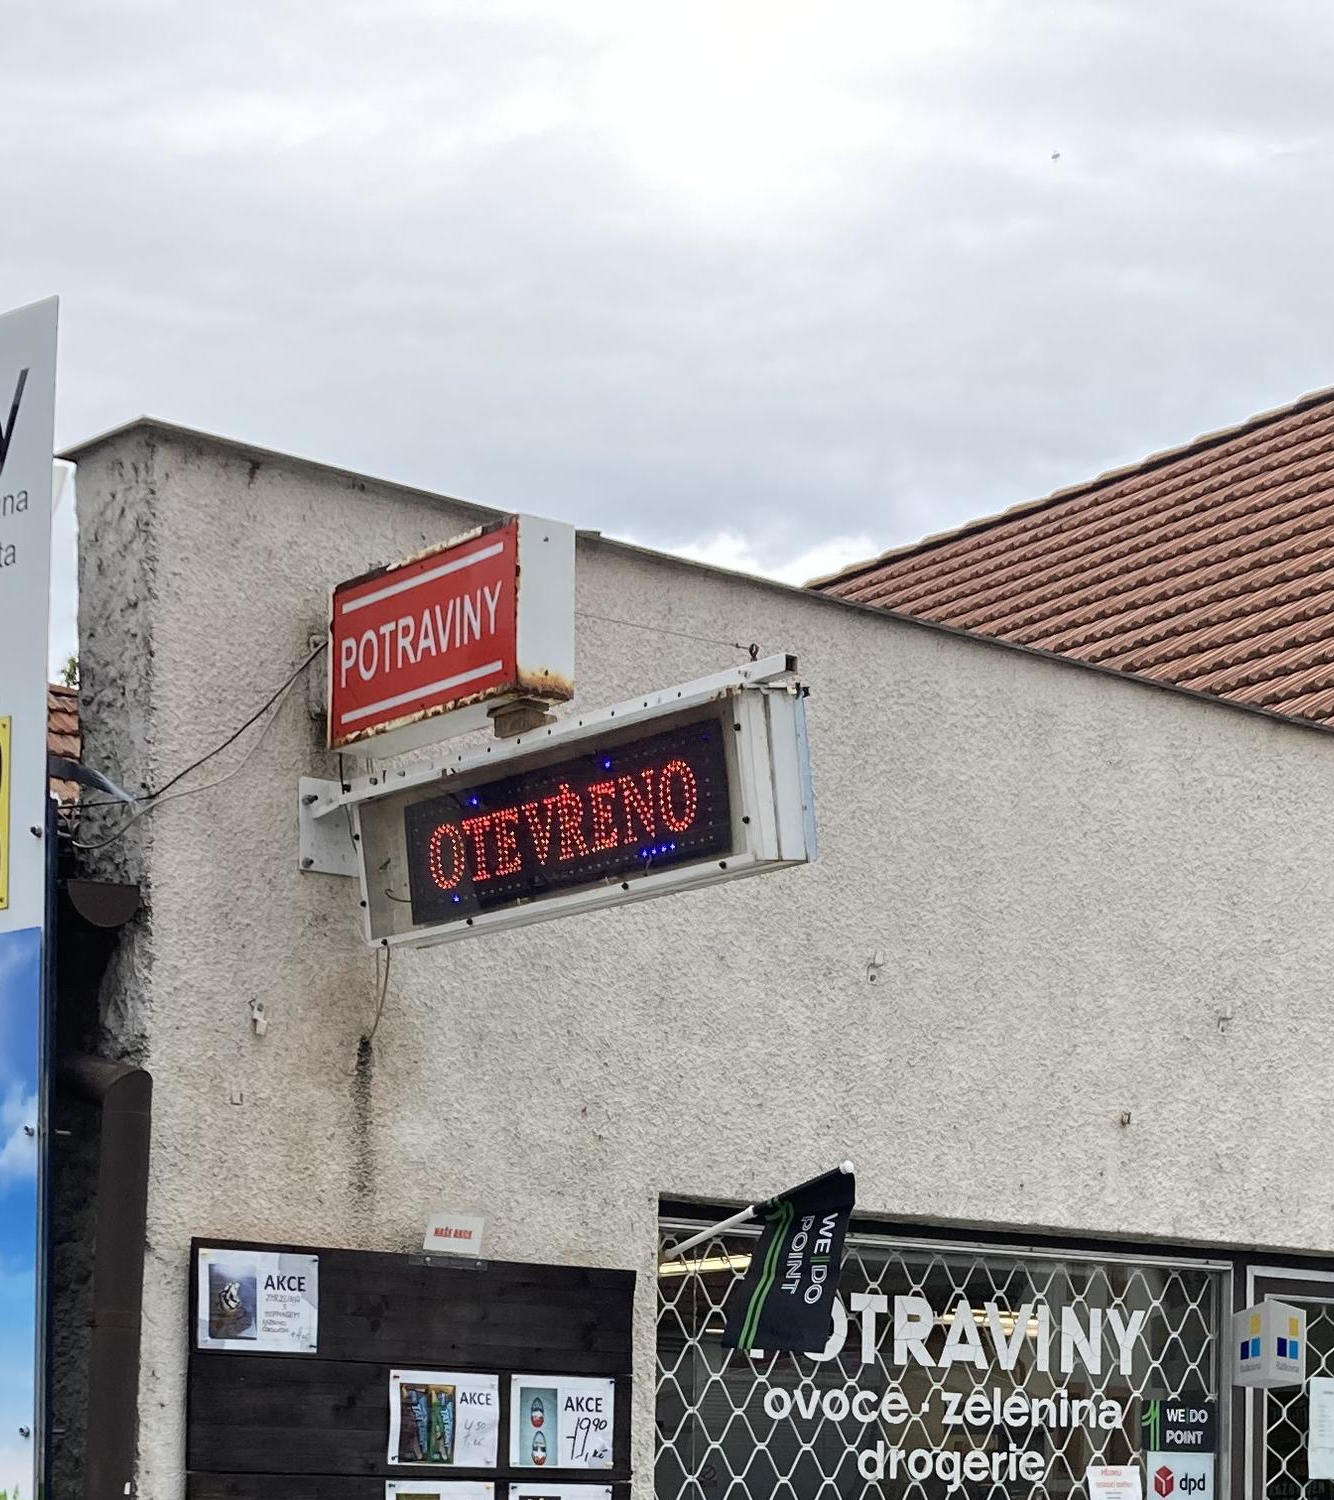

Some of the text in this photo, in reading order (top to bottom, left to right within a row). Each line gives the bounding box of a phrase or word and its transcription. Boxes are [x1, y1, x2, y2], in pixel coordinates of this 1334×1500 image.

[340, 579, 503, 689] POTRAVINY
[428, 759, 698, 890] OTEVŘENO
[780, 1215, 815, 1295] POINT
[264, 1275, 307, 1292] AKCE
[750, 1292, 1146, 1375] OTRAVINY
[459, 1392, 492, 1406] AKCE
[564, 1396, 603, 1413] AKCE
[764, 1385, 1123, 1430] ovoce zelenina
[1166, 1430, 1204, 1445] POINT
[858, 1441, 1045, 1492] drogerie
[1179, 1473, 1206, 1495] dpd
